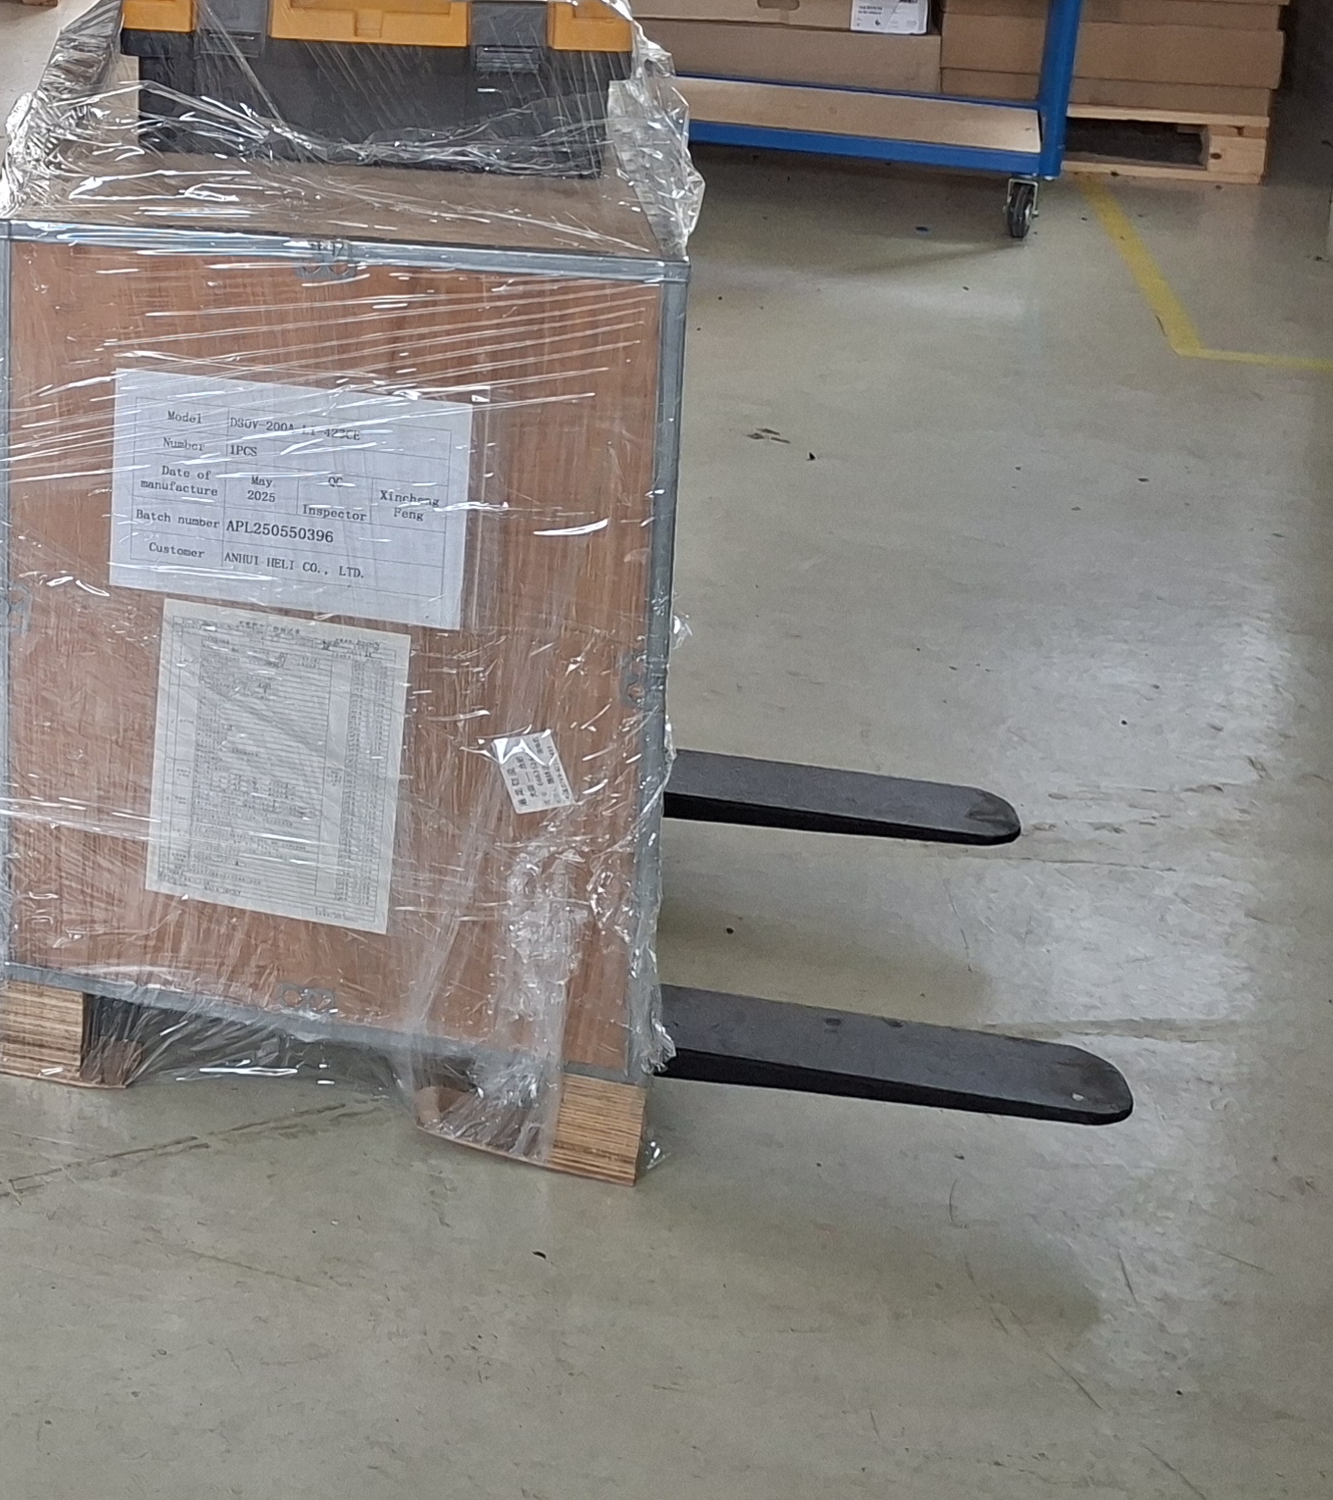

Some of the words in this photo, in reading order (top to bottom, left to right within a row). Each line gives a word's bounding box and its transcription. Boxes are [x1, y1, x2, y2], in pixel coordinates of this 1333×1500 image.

[167, 410, 202, 424] Model
[162, 437, 205, 451] Number
[161, 465, 190, 480] Date
[197, 470, 212, 481] of
[140, 478, 219, 497] manufacture
[251, 476, 273, 488] May
[247, 490, 276, 503] 2025
[302, 504, 367, 522] Inspector
[394, 507, 424, 522] Feng
[135, 509, 171, 524] Batch
[178, 515, 220, 529] number
[226, 520, 334, 543] APL250550396
[149, 542, 205, 558] Customer
[224, 552, 259, 566] ANHUI
[267, 557, 295, 571] HELI
[339, 565, 364, 579] LTD.
